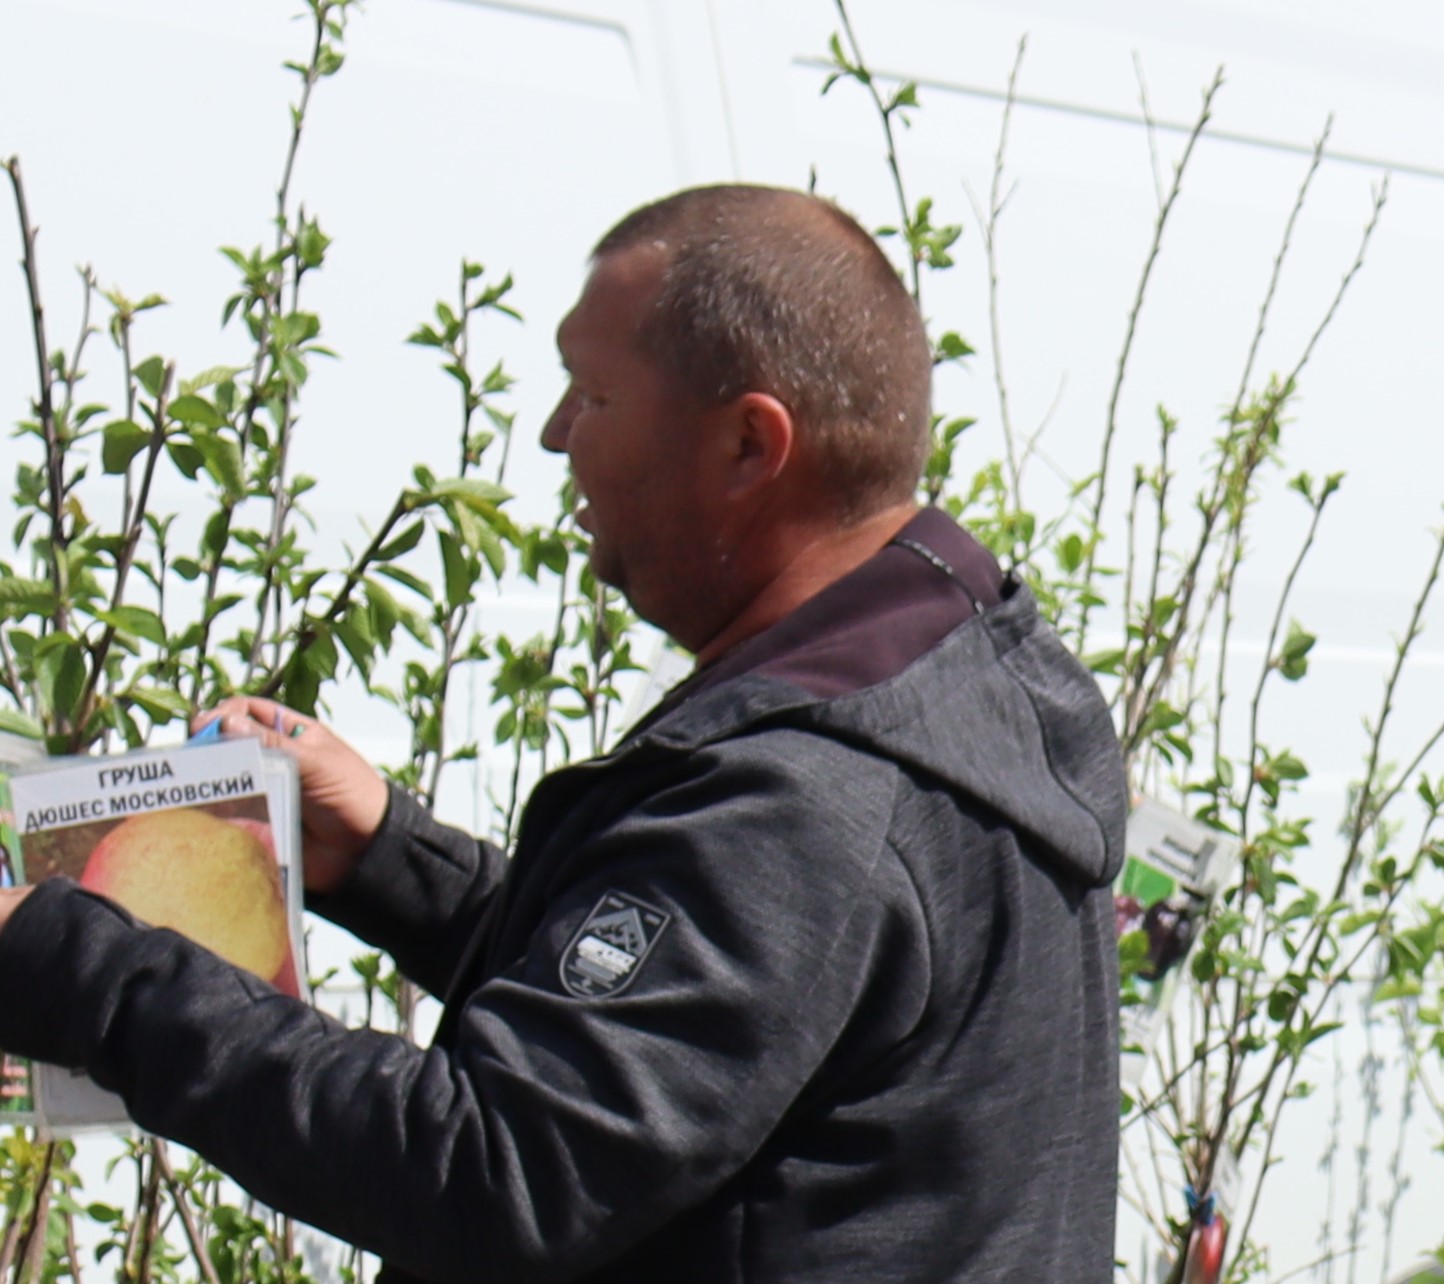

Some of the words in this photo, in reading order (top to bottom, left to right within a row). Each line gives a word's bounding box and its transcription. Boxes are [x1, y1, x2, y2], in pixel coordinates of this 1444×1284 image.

[98, 760, 173, 788] ГРУША
[25, 801, 104, 833] ДЮШЕС
[110, 773, 255, 814] МОСКОВСКИЙ
